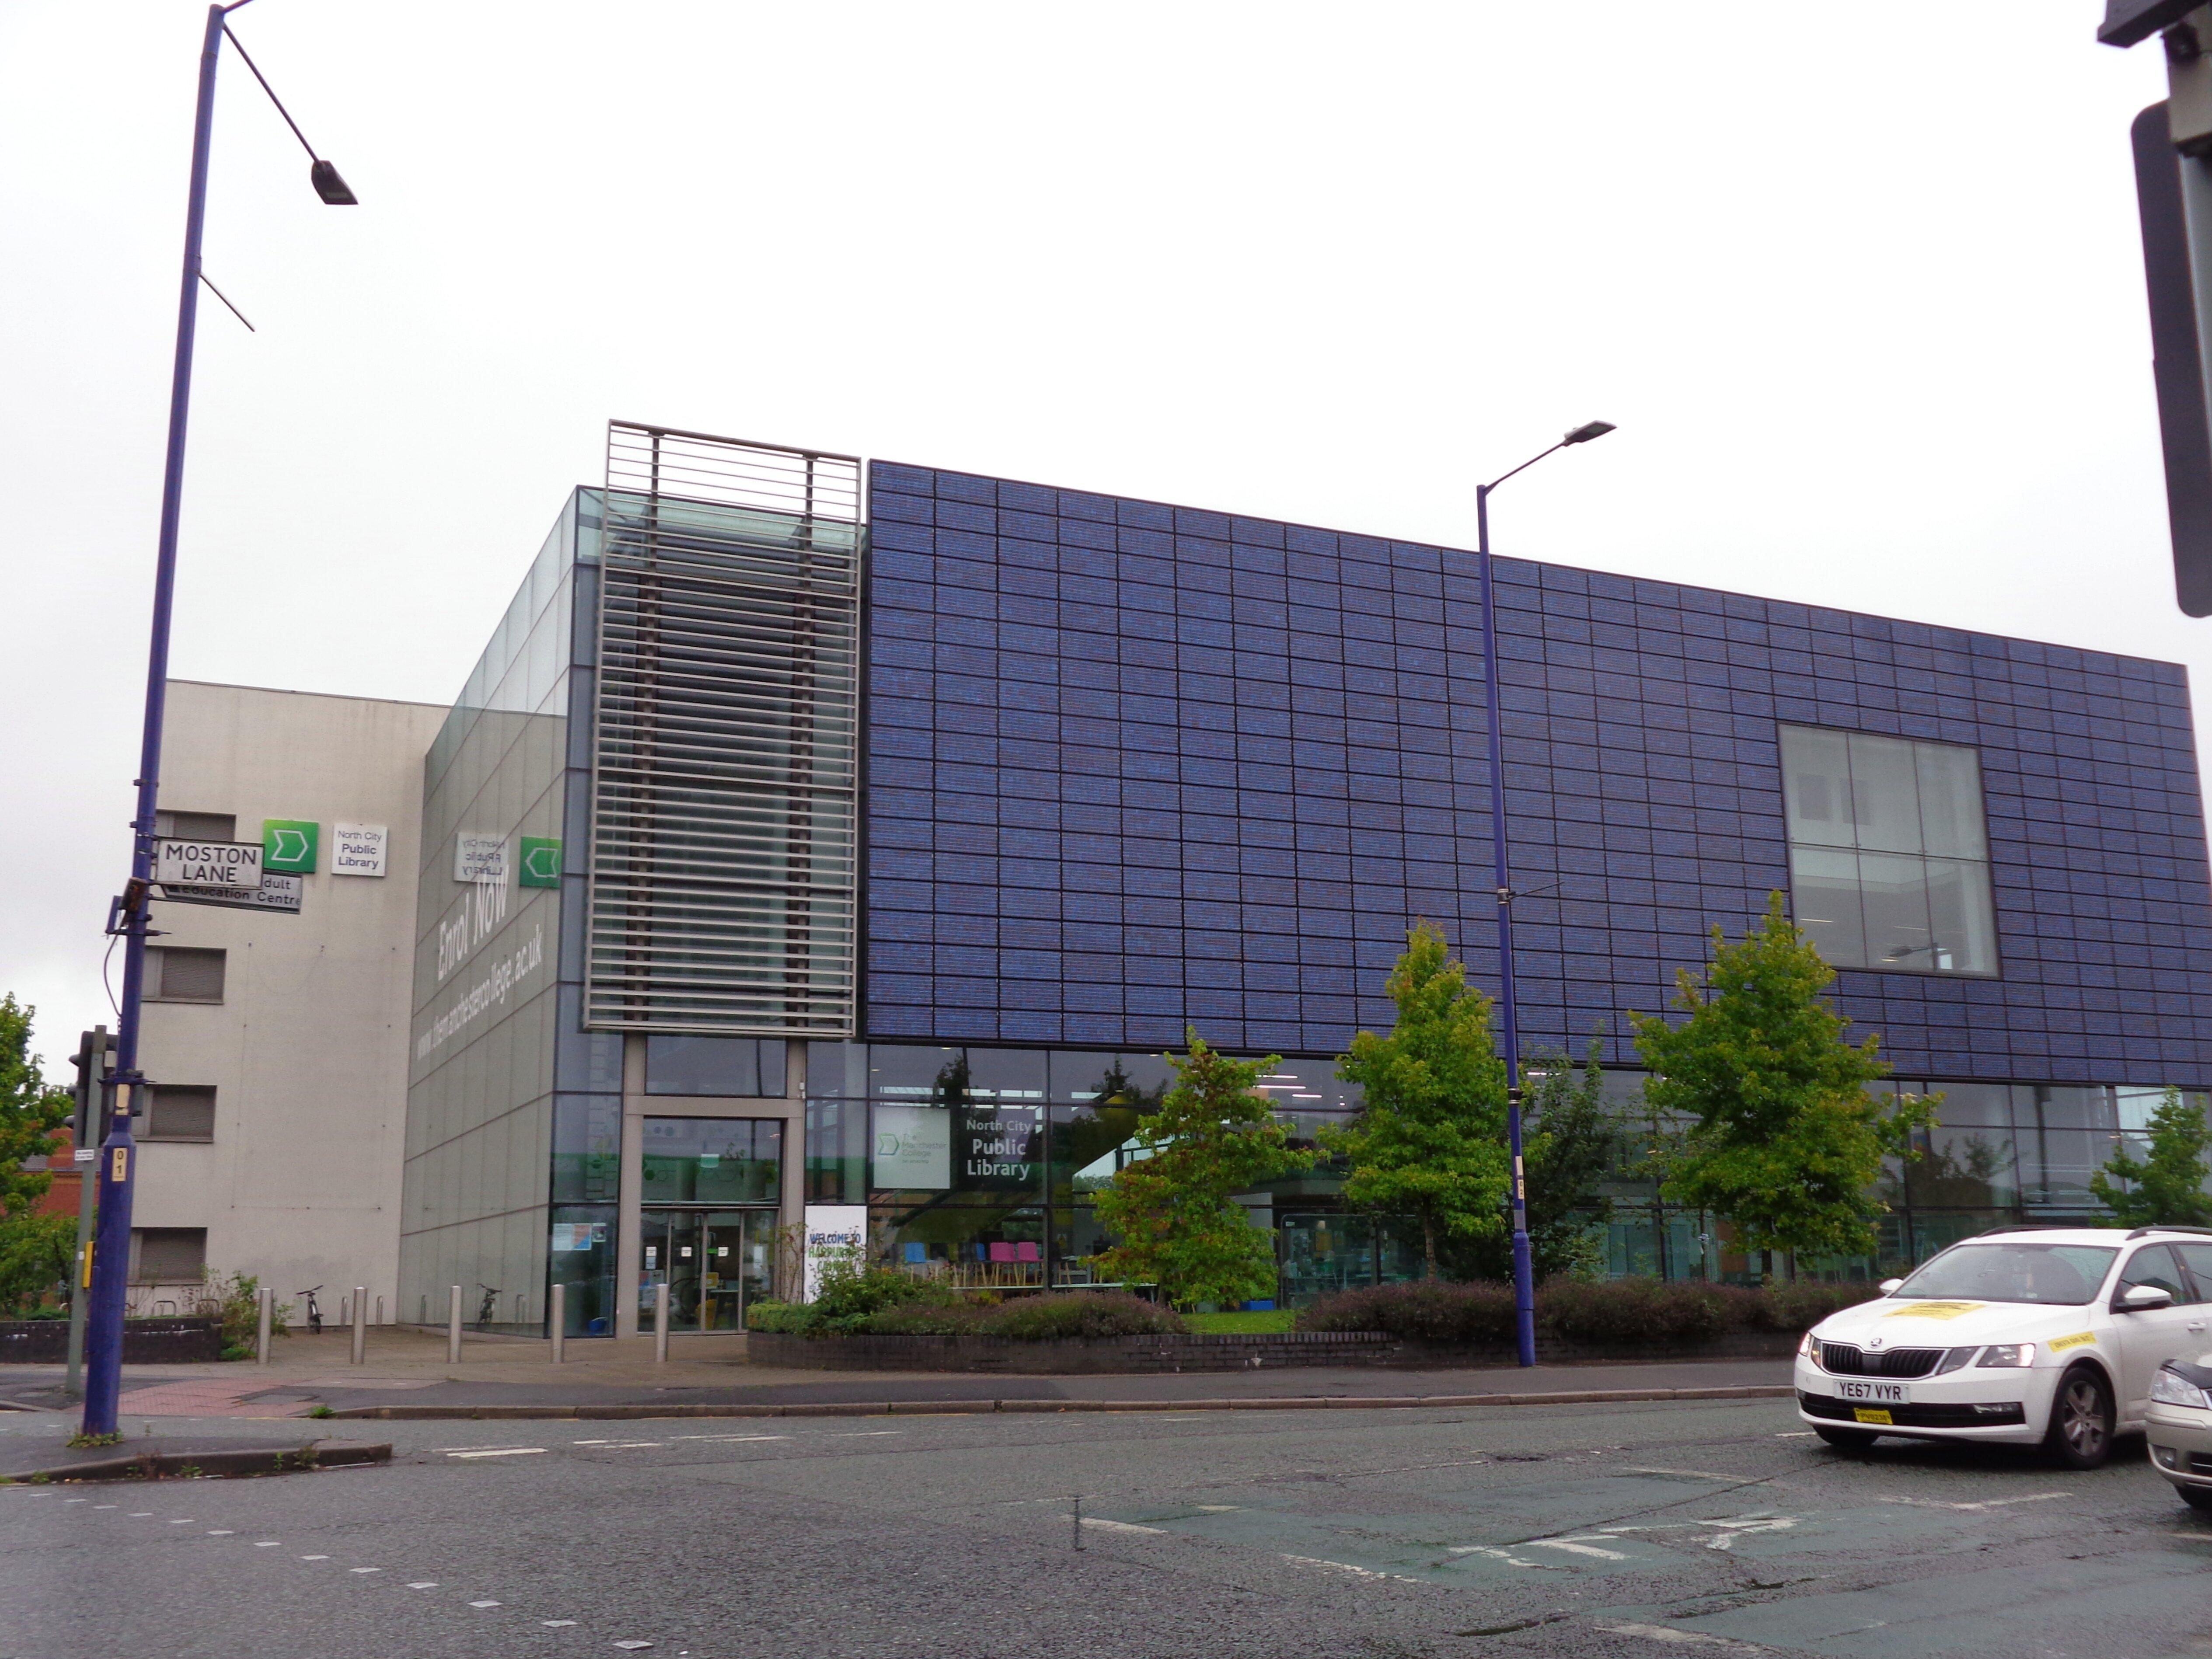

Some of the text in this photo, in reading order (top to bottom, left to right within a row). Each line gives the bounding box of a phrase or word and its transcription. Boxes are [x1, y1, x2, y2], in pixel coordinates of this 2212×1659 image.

[338, 830, 381, 842] North City
[166, 844, 256, 864] MOSTON
[342, 843, 377, 854] Public
[338, 857, 379, 869] Library
[183, 864, 237, 883] LANE
[263, 878, 290, 890] dult
[257, 891, 300, 904] Centre
[438, 892, 470, 980] Enrol
[966, 1119, 1031, 1134] North City
[973, 1138, 1026, 1155] Public
[967, 1159, 1030, 1181] Library
[1840, 1382, 1901, 1400] YE67 VYR
